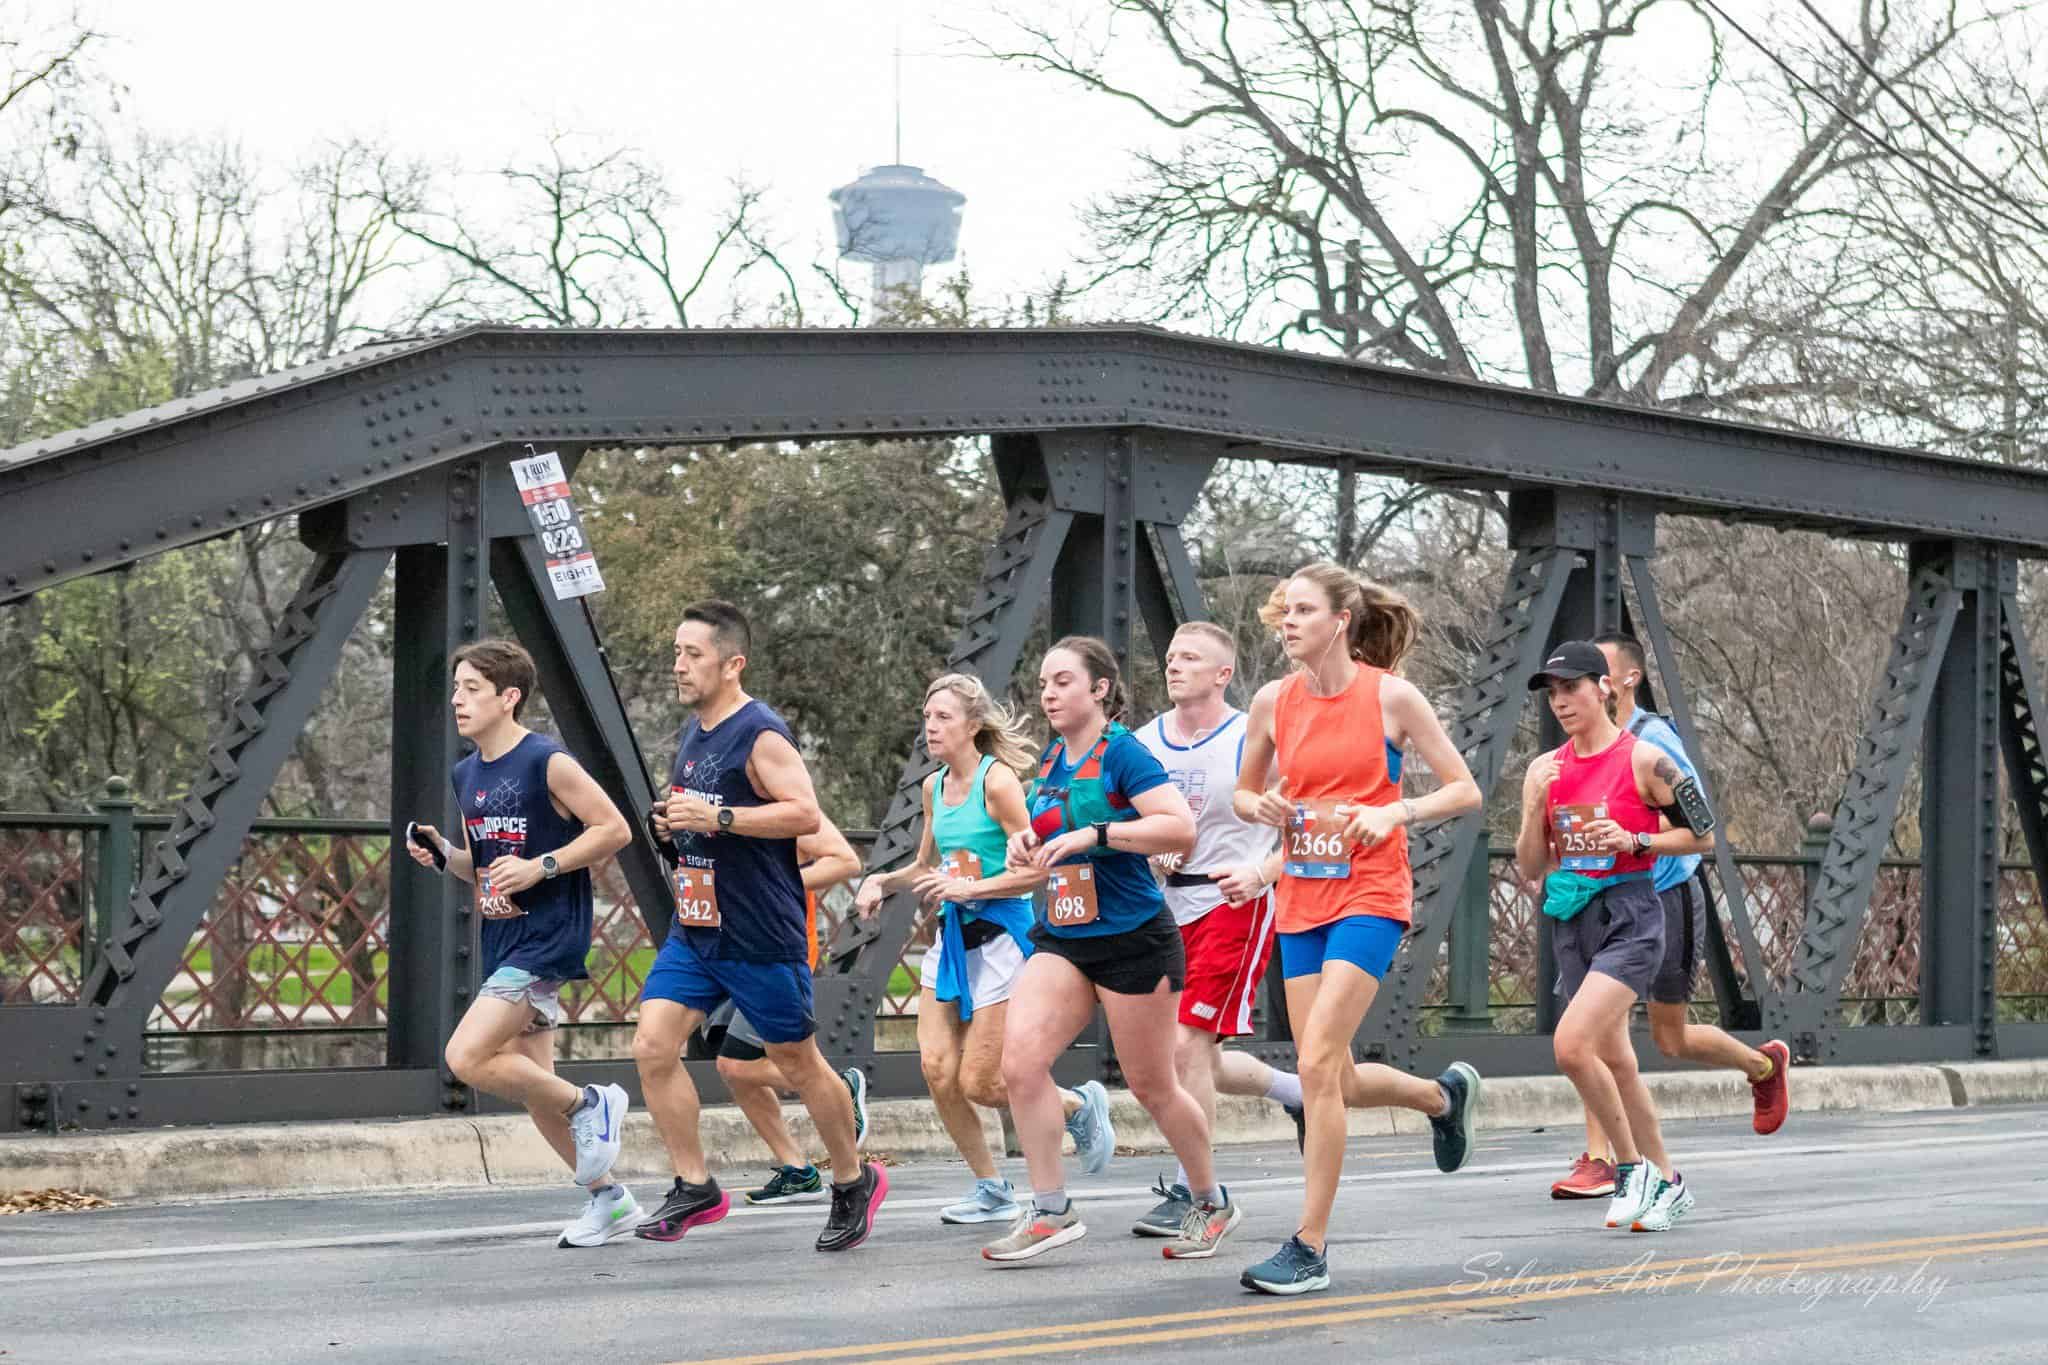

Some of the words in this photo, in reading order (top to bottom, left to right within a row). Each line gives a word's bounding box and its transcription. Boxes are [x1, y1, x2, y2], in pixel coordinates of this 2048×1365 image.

[553, 565, 592, 582] EIGHT
[1292, 832, 1343, 856] 2366
[1055, 895, 1085, 919] 698
